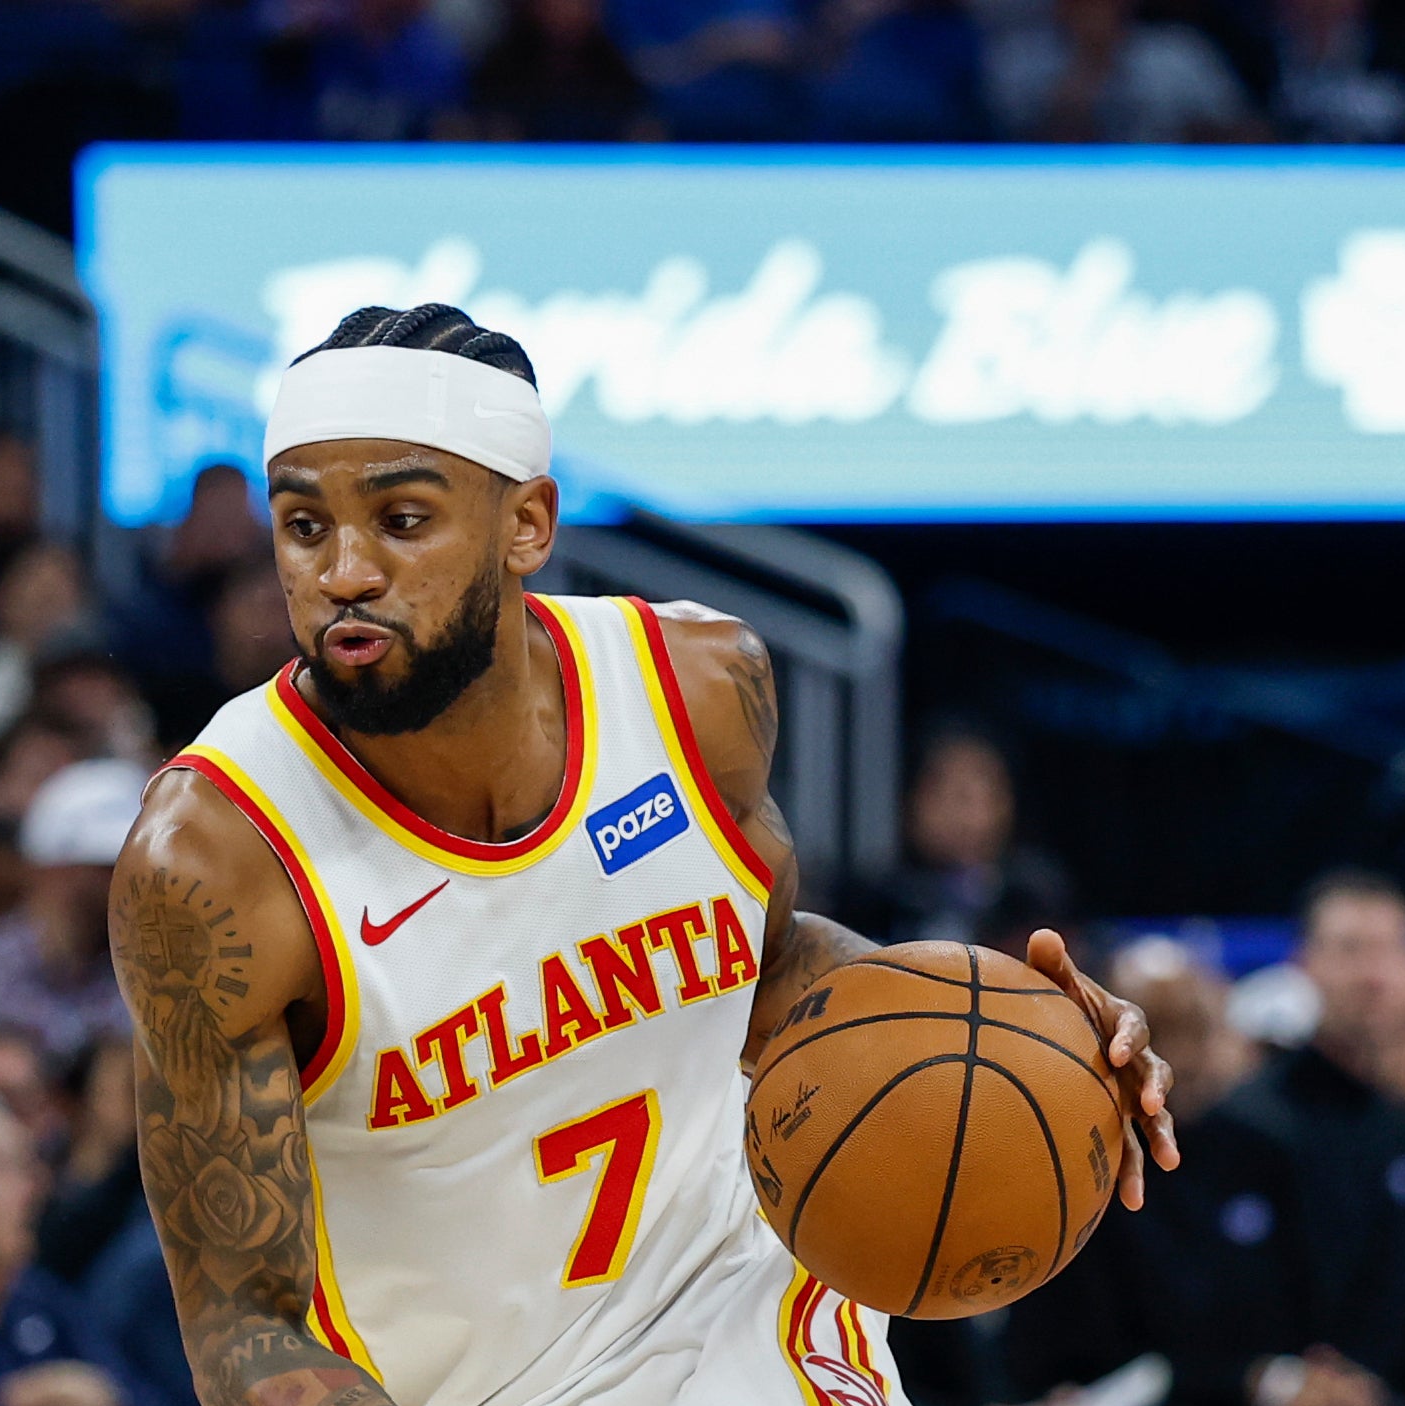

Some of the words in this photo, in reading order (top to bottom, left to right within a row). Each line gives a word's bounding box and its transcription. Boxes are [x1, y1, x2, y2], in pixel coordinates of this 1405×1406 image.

[904, 237, 1281, 424] Blue
[595, 791, 675, 861] paze
[367, 894, 760, 1132] ATLANTA
[532, 1087, 663, 1290] 7
